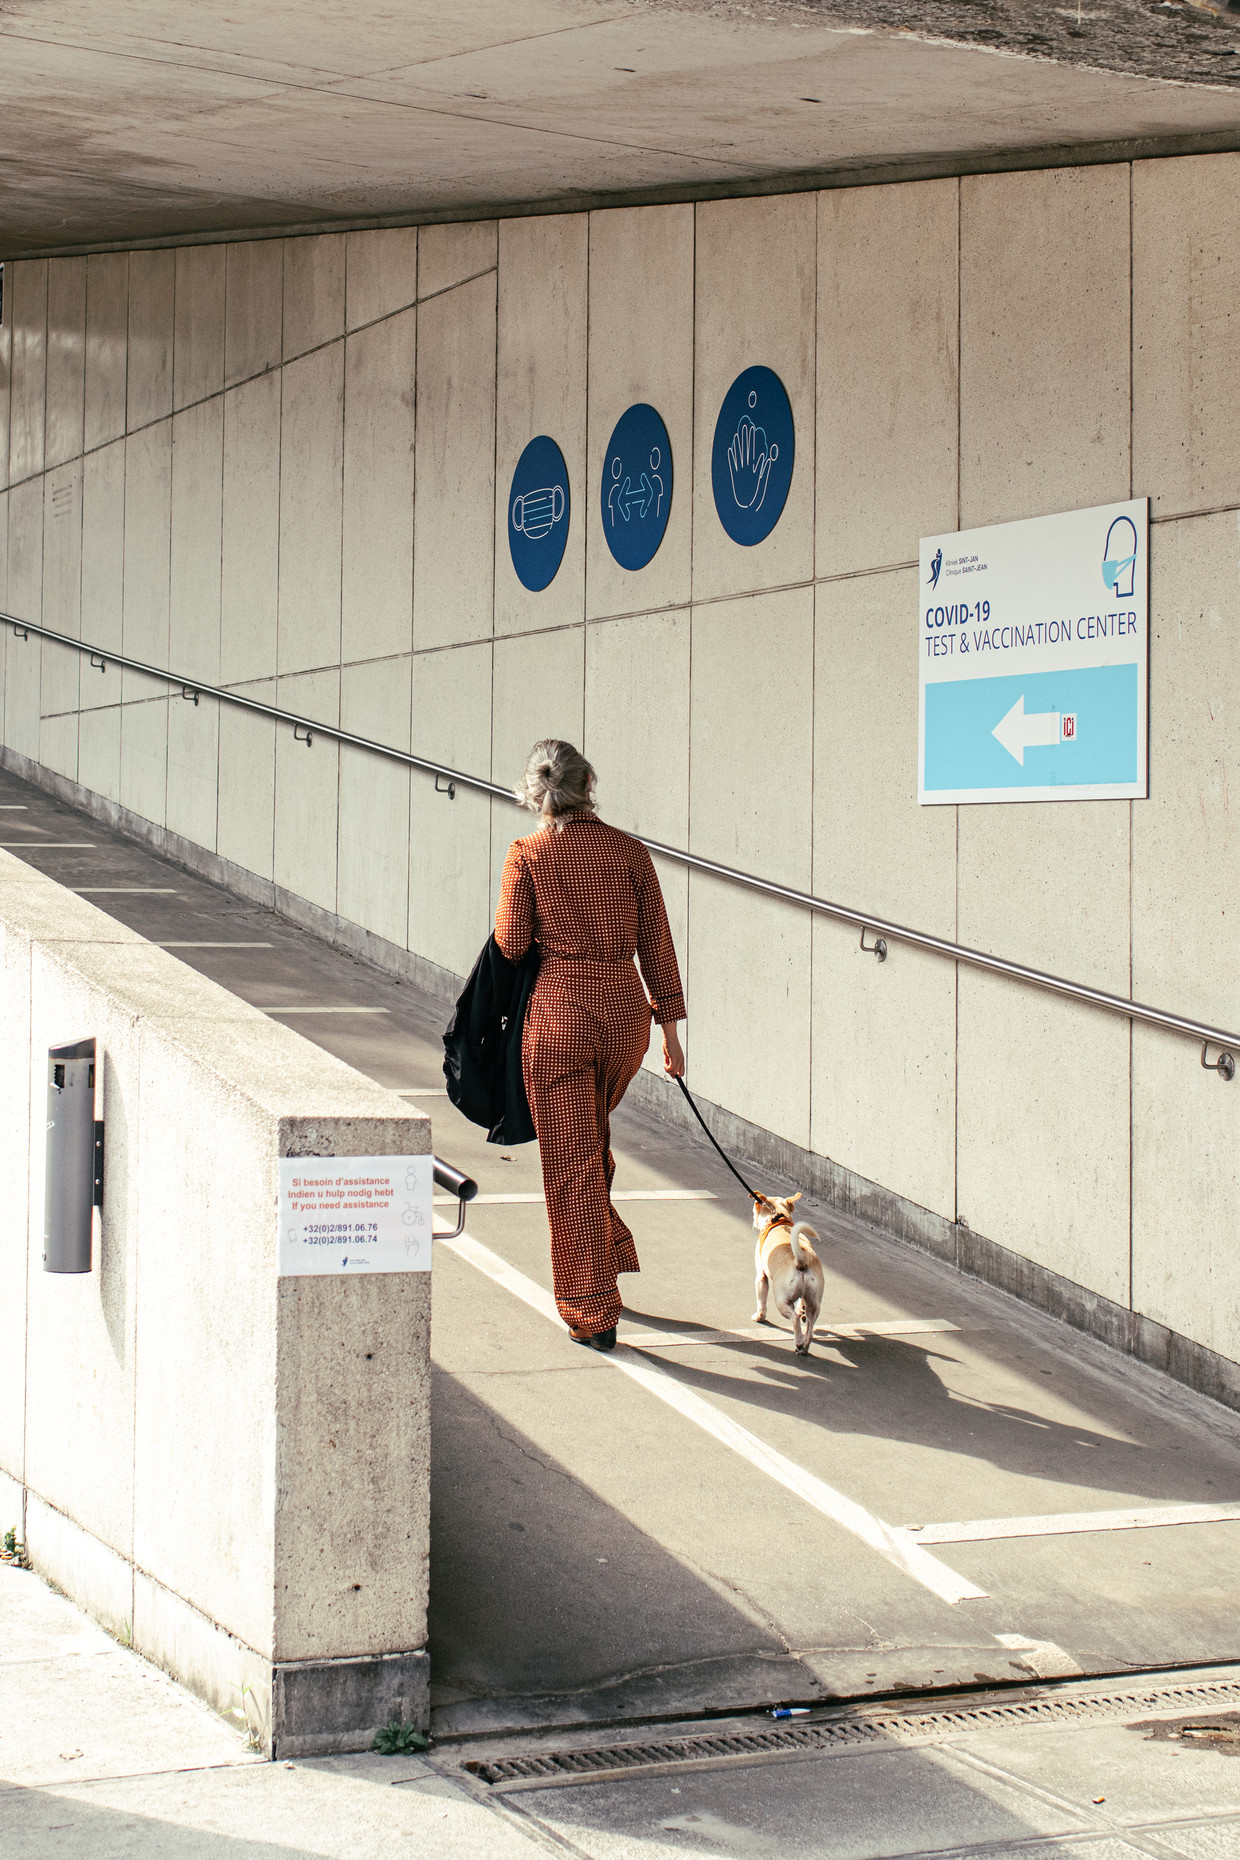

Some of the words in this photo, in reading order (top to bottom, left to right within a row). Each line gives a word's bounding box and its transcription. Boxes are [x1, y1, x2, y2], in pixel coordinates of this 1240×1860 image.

[945, 567, 962, 576] Clinique
[962, 563, 988, 573] SAINT-JEAN
[925, 600, 991, 628] COVID-19
[925, 633, 956, 657] TEST
[959, 633, 970, 653] &
[973, 619, 1072, 651] VACCINATION
[1076, 611, 1137, 640] CENTER
[292, 1178, 301, 1187] Si
[303, 1178, 333, 1186] besoin
[335, 1177, 390, 1186] d'assistance
[288, 1190, 315, 1198] Indien
[325, 1190, 345, 1199] hulp
[347, 1189, 372, 1199] nodig
[374, 1188, 394, 1197] hebt
[292, 1202, 298, 1210] If
[300, 1203, 317, 1212] you
[319, 1201, 340, 1209] need
[342, 1200, 389, 1209] assistance
[303, 1223, 378, 1234] +32(0)2/891.06.76
[302, 1235, 377, 1245] +32(0)2/891.06.74
